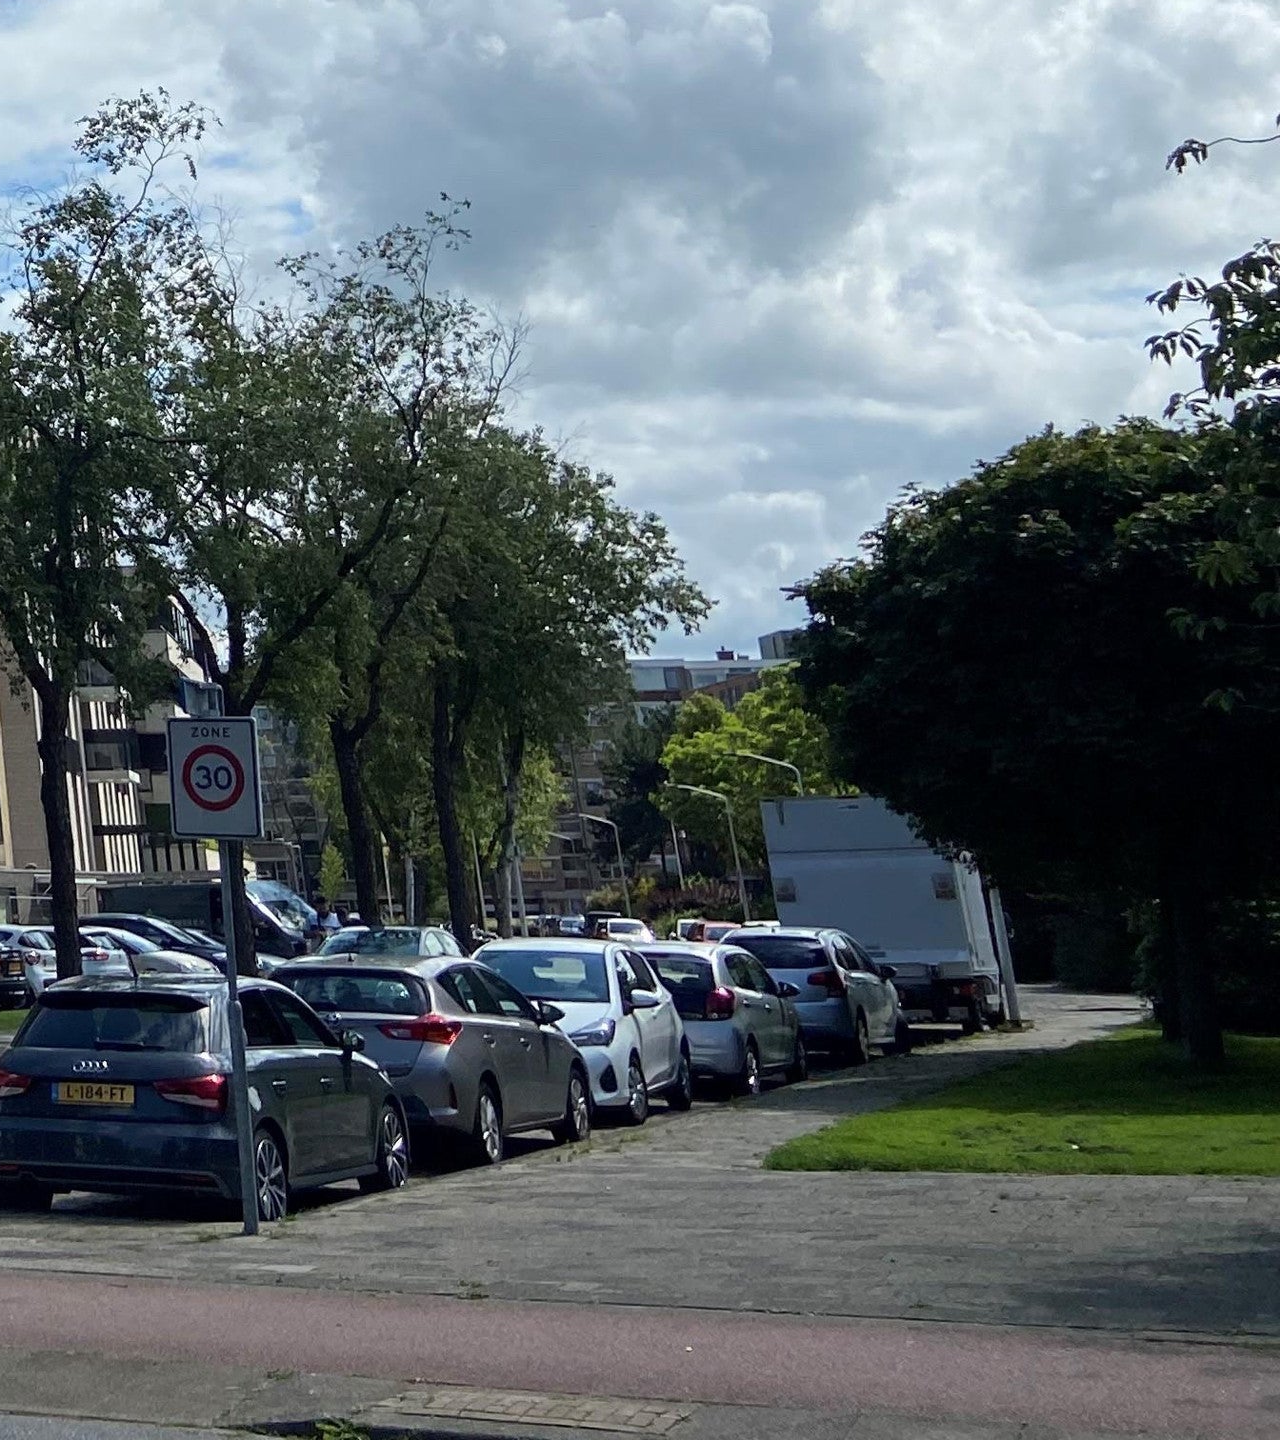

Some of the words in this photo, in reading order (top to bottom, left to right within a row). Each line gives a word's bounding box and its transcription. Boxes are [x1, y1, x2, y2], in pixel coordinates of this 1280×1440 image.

[191, 726, 231, 738] ZONE
[194, 764, 232, 790] 30
[66, 1084, 127, 1101] L-184-FT
